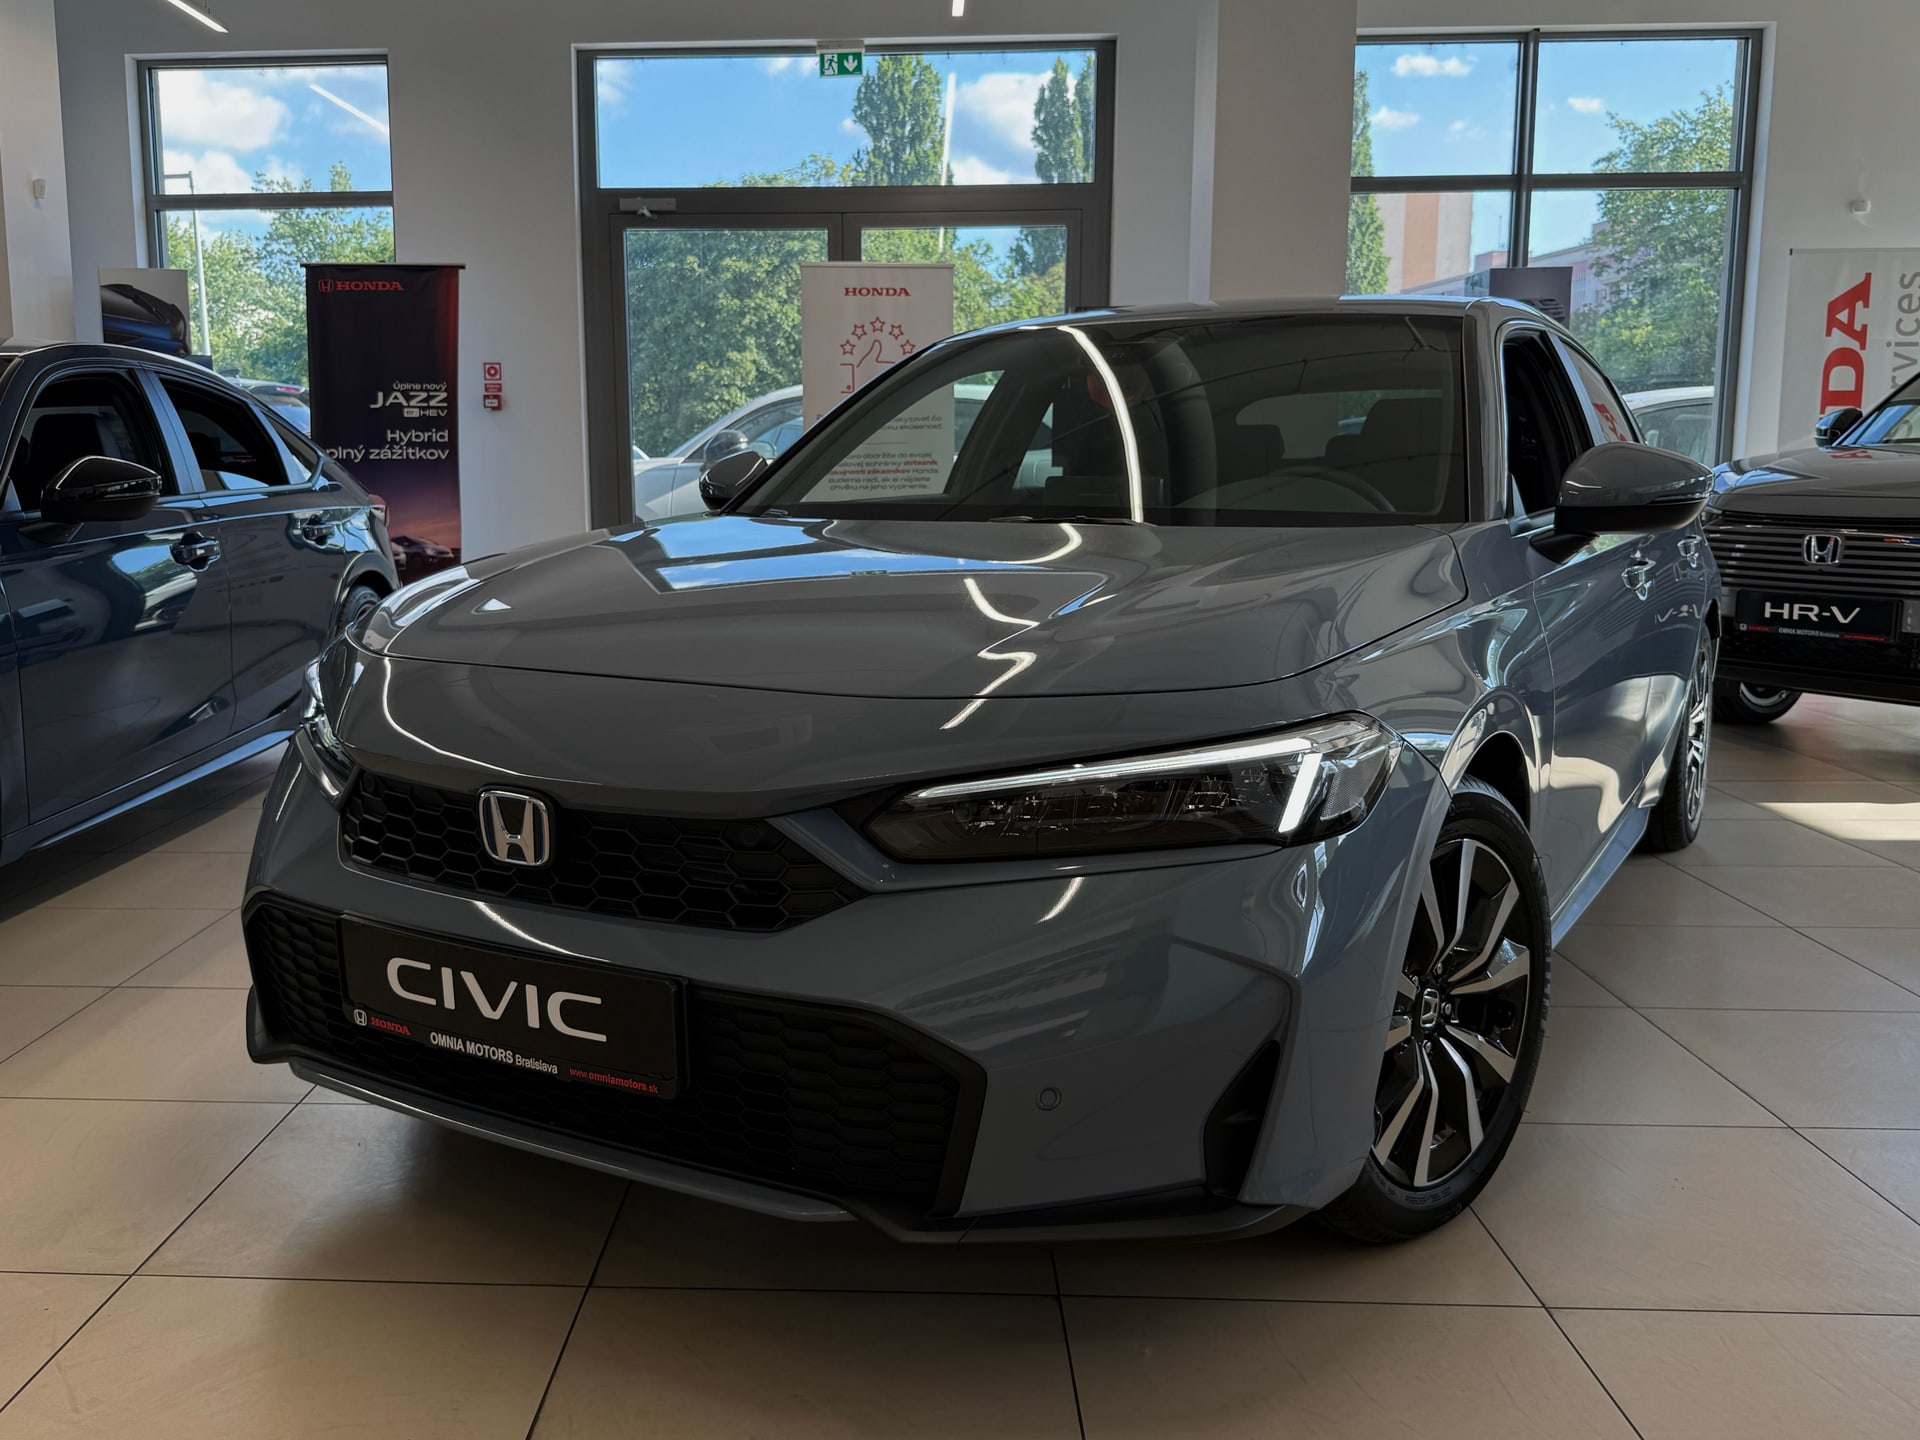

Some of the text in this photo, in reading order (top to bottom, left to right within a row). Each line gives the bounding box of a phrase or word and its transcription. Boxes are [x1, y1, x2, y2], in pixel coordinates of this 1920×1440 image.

[336, 281, 404, 291] HONDA
[844, 287, 912, 297] HONDA
[1886, 271, 1920, 389] rvices
[1819, 272, 1872, 415] DA
[393, 380, 448, 391] Úplne nový
[370, 391, 448, 408] JAZZ
[387, 429, 449, 445] Hybrid
[369, 444, 450, 460] zážitkov
[1764, 602, 1861, 624] HR-V
[387, 957, 607, 1042] CIVIC
[370, 1017, 411, 1036] HONDA
[430, 1031, 558, 1075] OMNIA MOTORS Bratislava
[569, 1067, 659, 1095] www.omniamotors.sk
